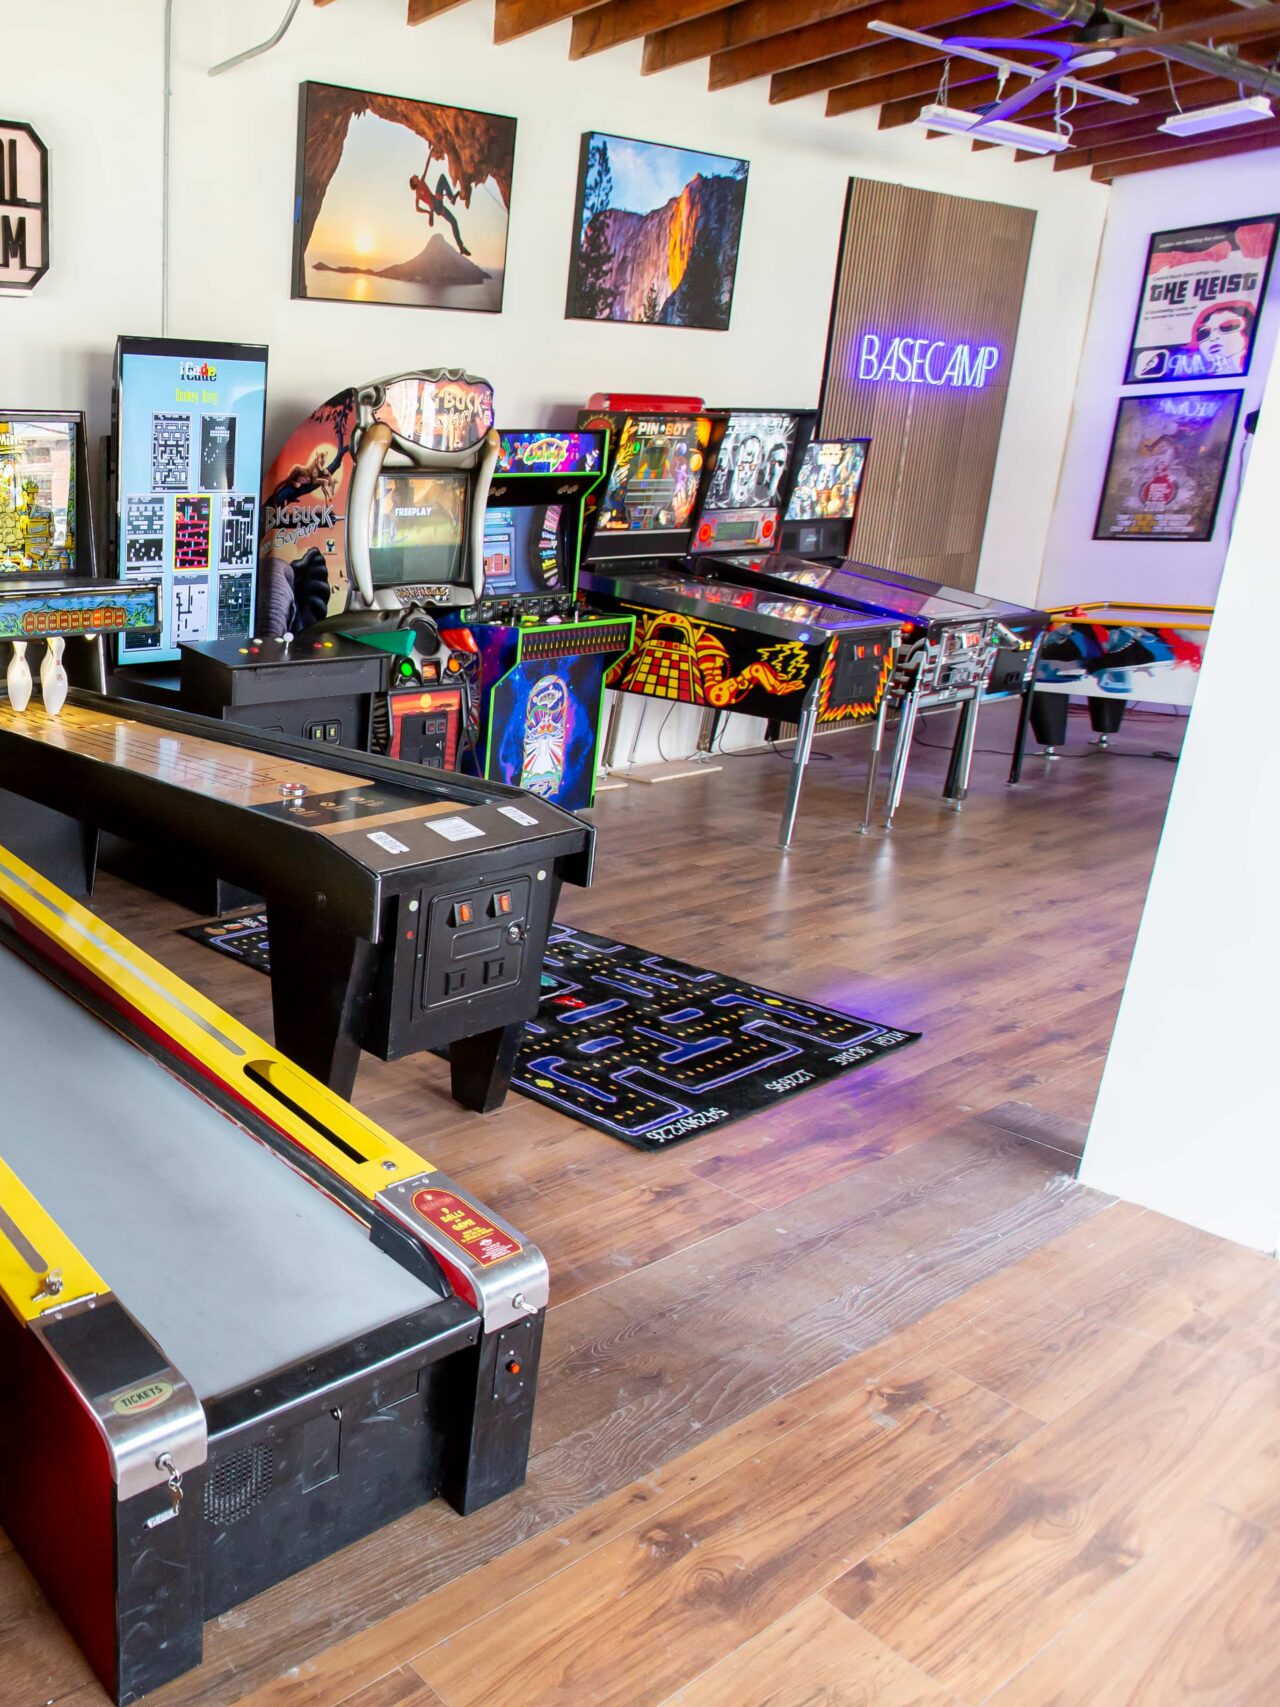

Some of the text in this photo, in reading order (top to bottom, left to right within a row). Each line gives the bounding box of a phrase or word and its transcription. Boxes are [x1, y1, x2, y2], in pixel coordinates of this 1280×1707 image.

[1150, 280, 1189, 305] THE
[1193, 272, 1259, 301] HEIST
[859, 334, 999, 388] BASECAMP
[637, 421, 691, 436] PIN BOT
[265, 501, 334, 529] BIG BUCK
[395, 506, 432, 517] FREEPLAY
[827, 1030, 909, 1066] HIGH SCORE
[440, 1210, 465, 1223] BALLS
[451, 1219, 476, 1231] GAME
[120, 1384, 163, 1407] TICKETS
